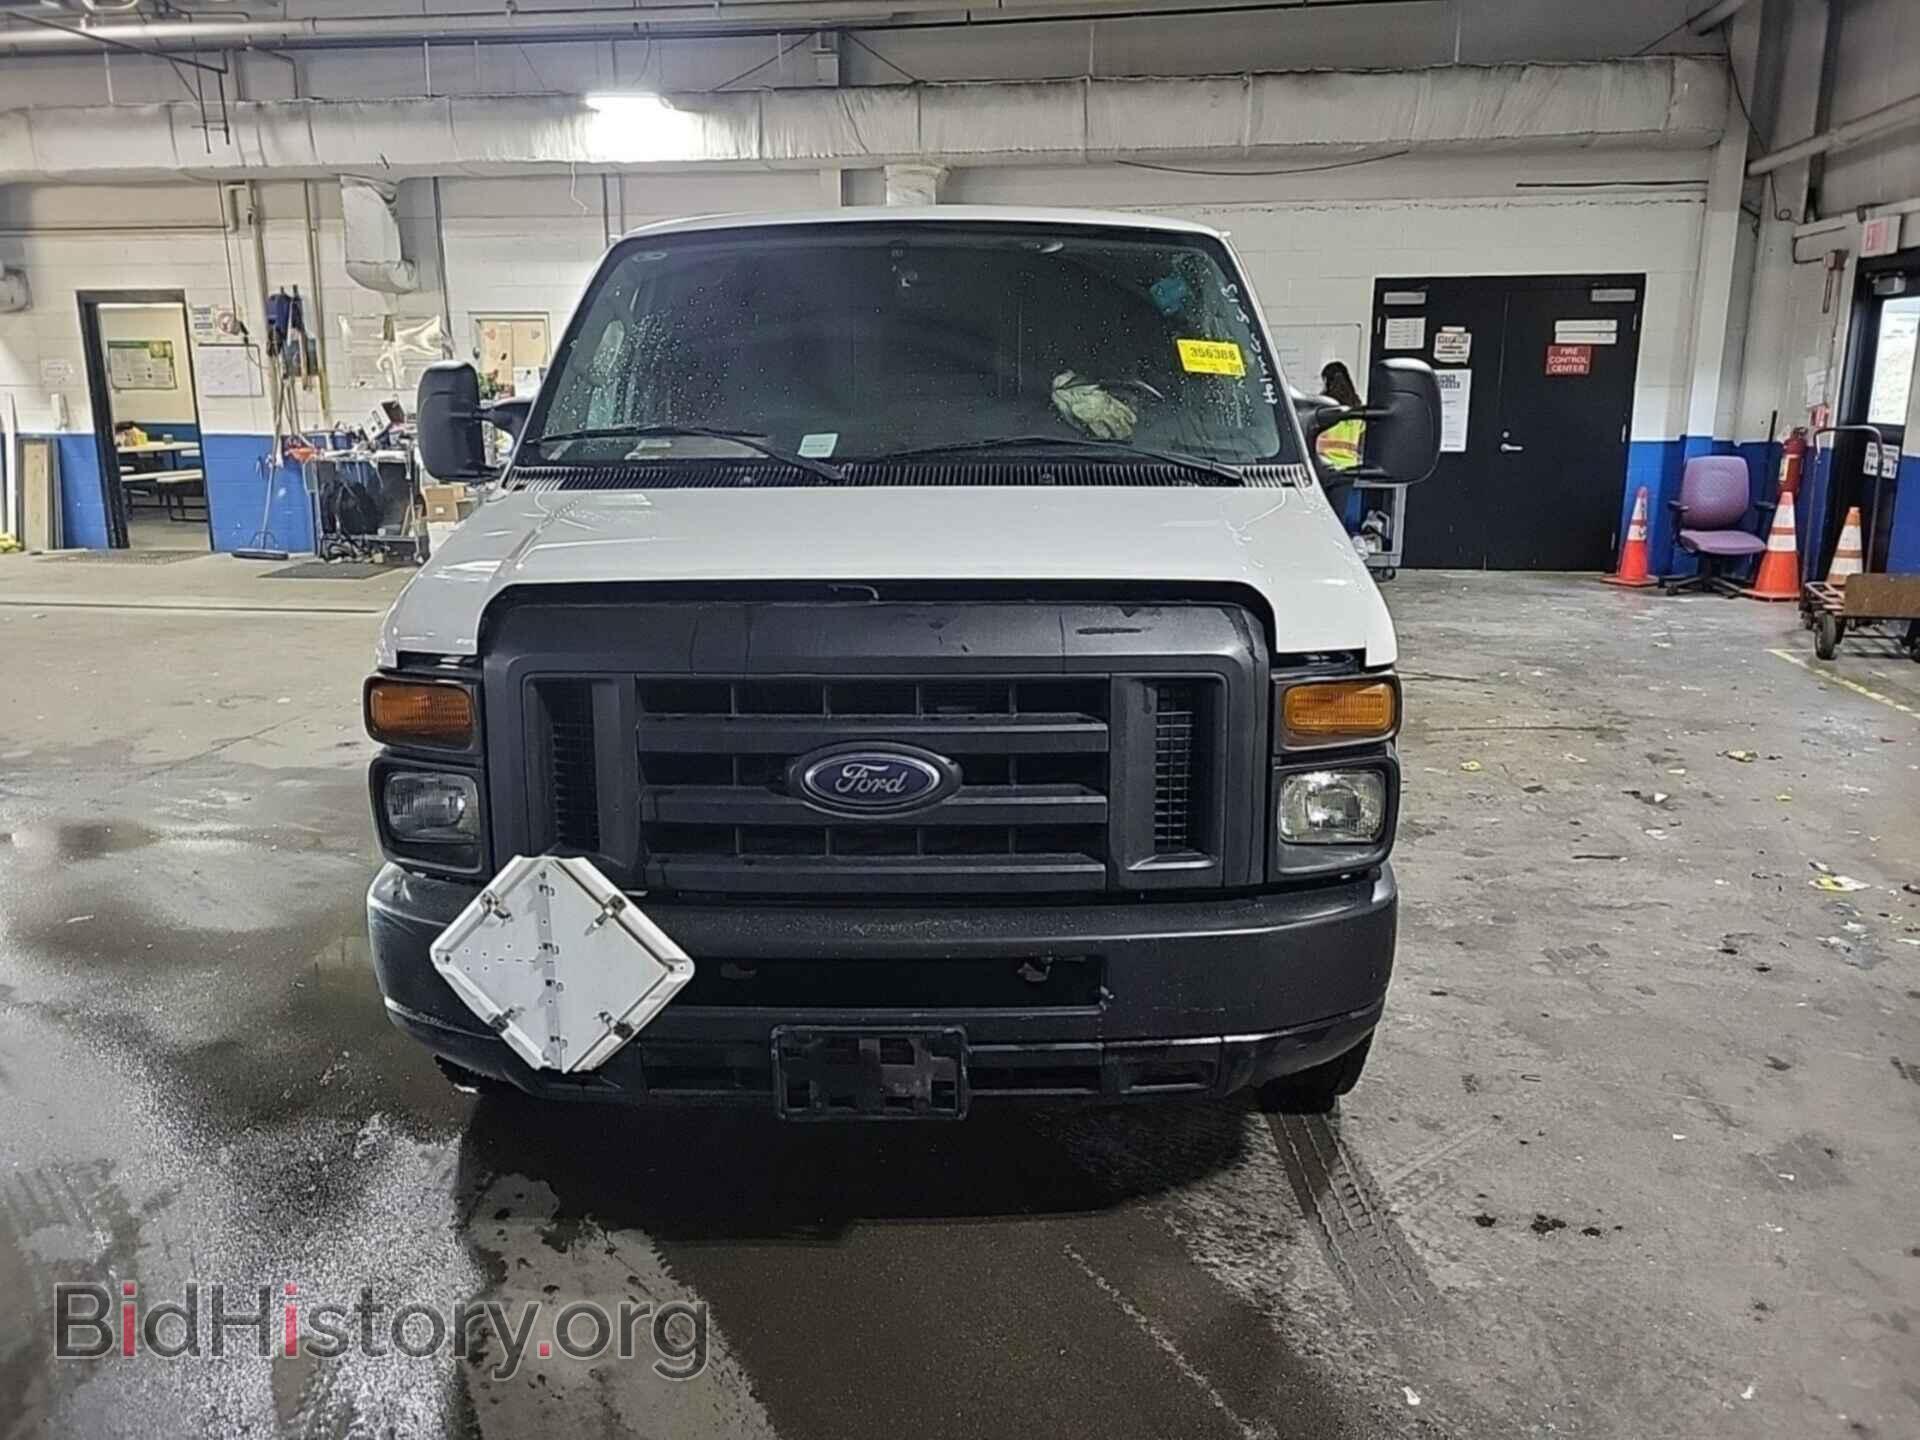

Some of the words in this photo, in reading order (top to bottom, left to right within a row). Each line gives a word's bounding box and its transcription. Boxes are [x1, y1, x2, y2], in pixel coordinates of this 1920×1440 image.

[1551, 356, 1587, 364] CONTROL
[1551, 364, 1585, 373] CENTER
[835, 763, 907, 793] Ford
